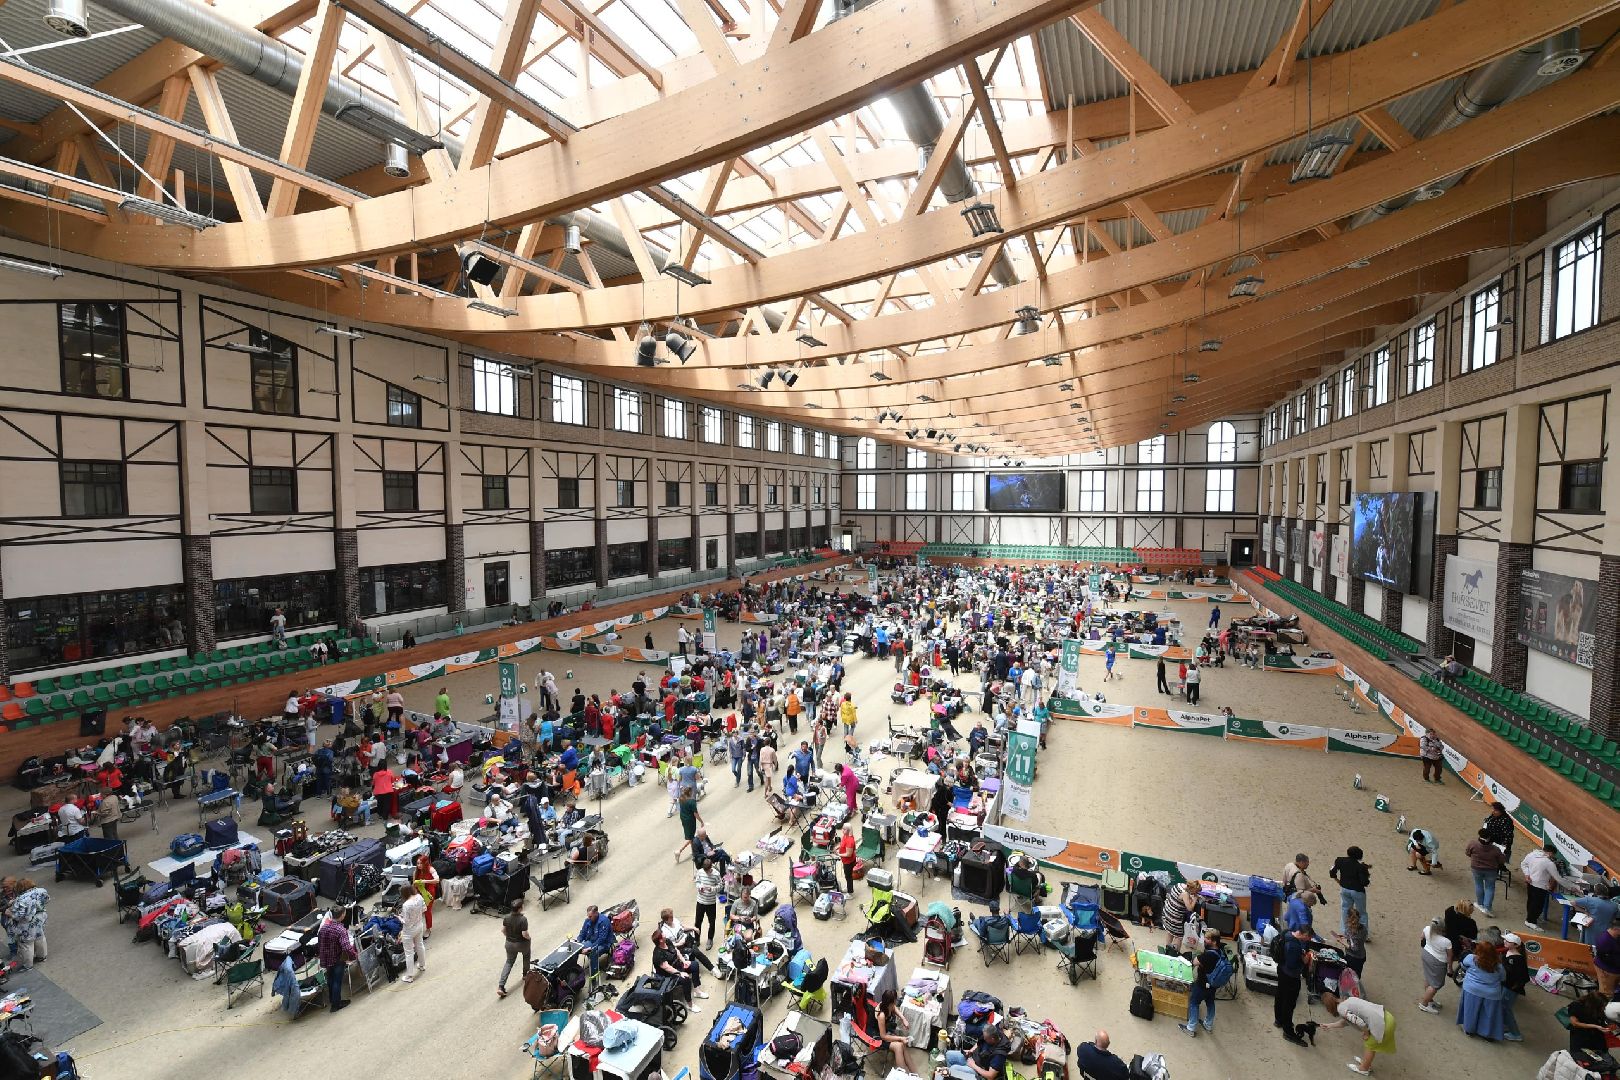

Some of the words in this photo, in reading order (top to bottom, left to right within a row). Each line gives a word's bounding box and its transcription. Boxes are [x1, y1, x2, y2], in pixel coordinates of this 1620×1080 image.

[1066, 653, 1078, 666] 12
[1180, 713, 1211, 723] AlphaPet
[1344, 732, 1381, 741] AlphaPet
[1015, 753, 1031, 774] 11
[1376, 799, 1384, 810] 2
[1003, 831, 1047, 847] AlphaPet
